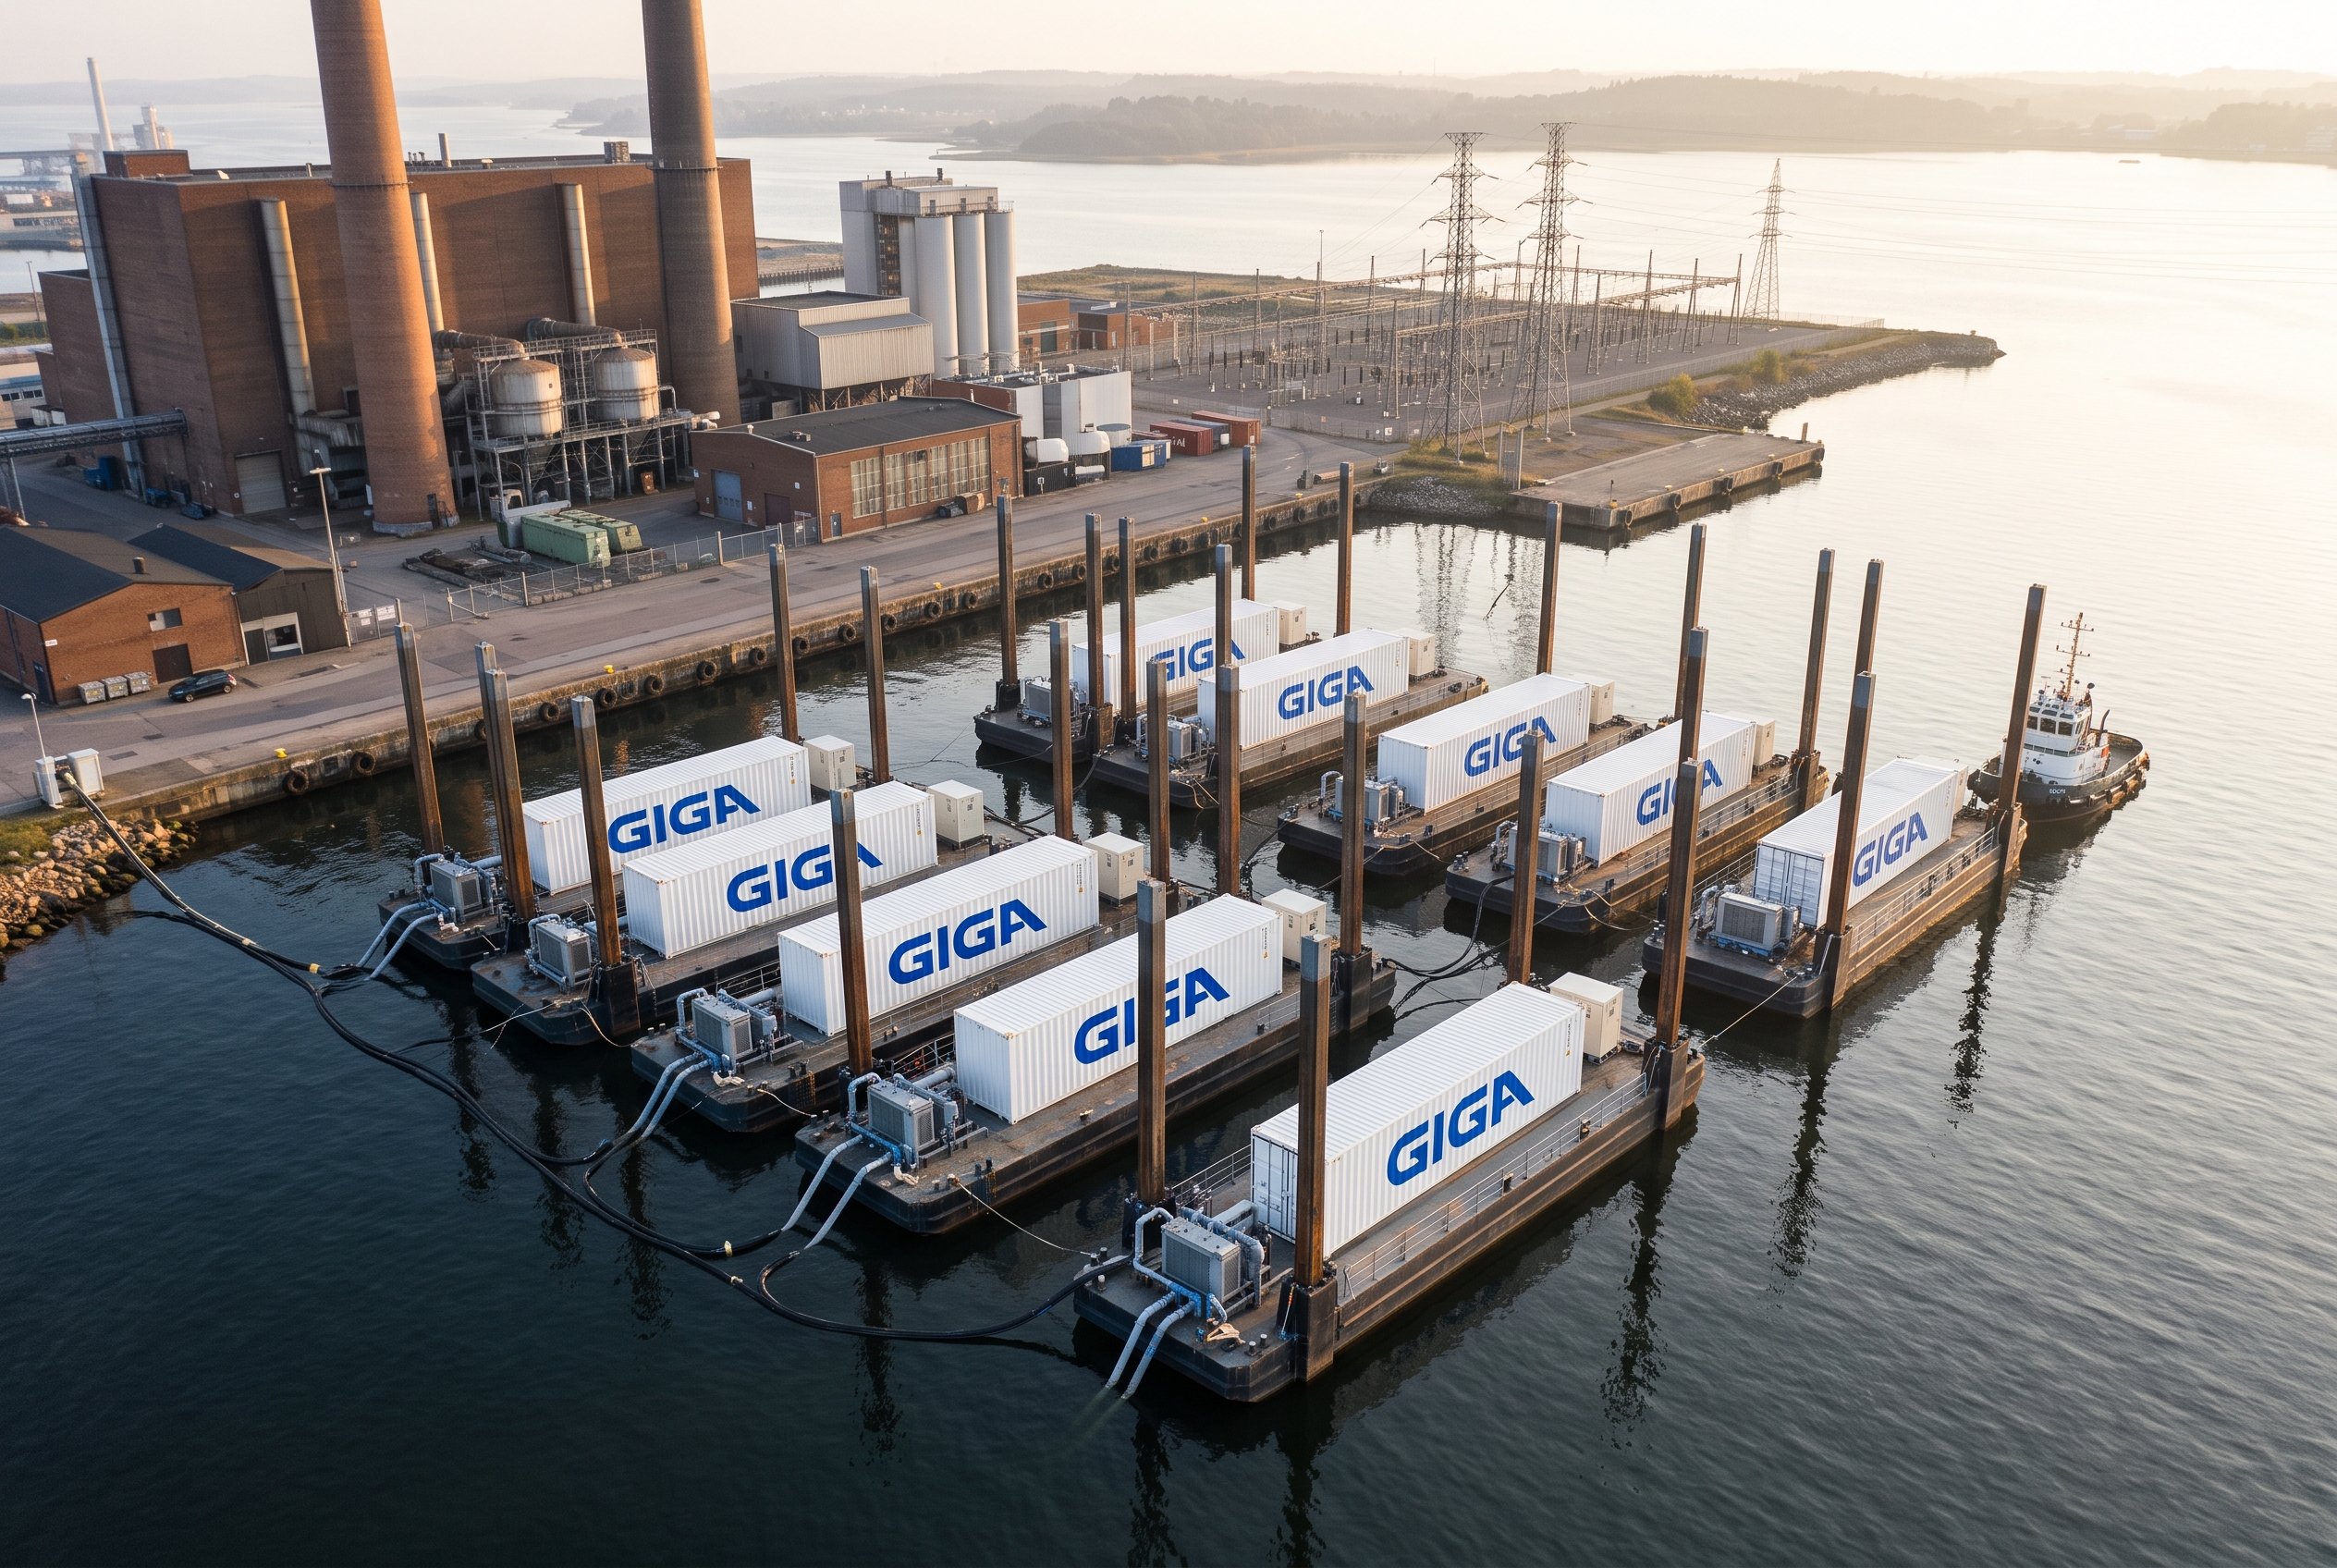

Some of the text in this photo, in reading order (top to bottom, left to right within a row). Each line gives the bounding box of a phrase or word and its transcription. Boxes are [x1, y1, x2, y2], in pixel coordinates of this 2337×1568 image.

[1279, 666, 1375, 720] GIGA
[608, 785, 761, 853] GIGA
[1637, 759, 1722, 826] GIA
[1853, 812, 1927, 887] GIGA
[888, 900, 1046, 985] GIGA
[1387, 1071, 1535, 1186] GIGA
